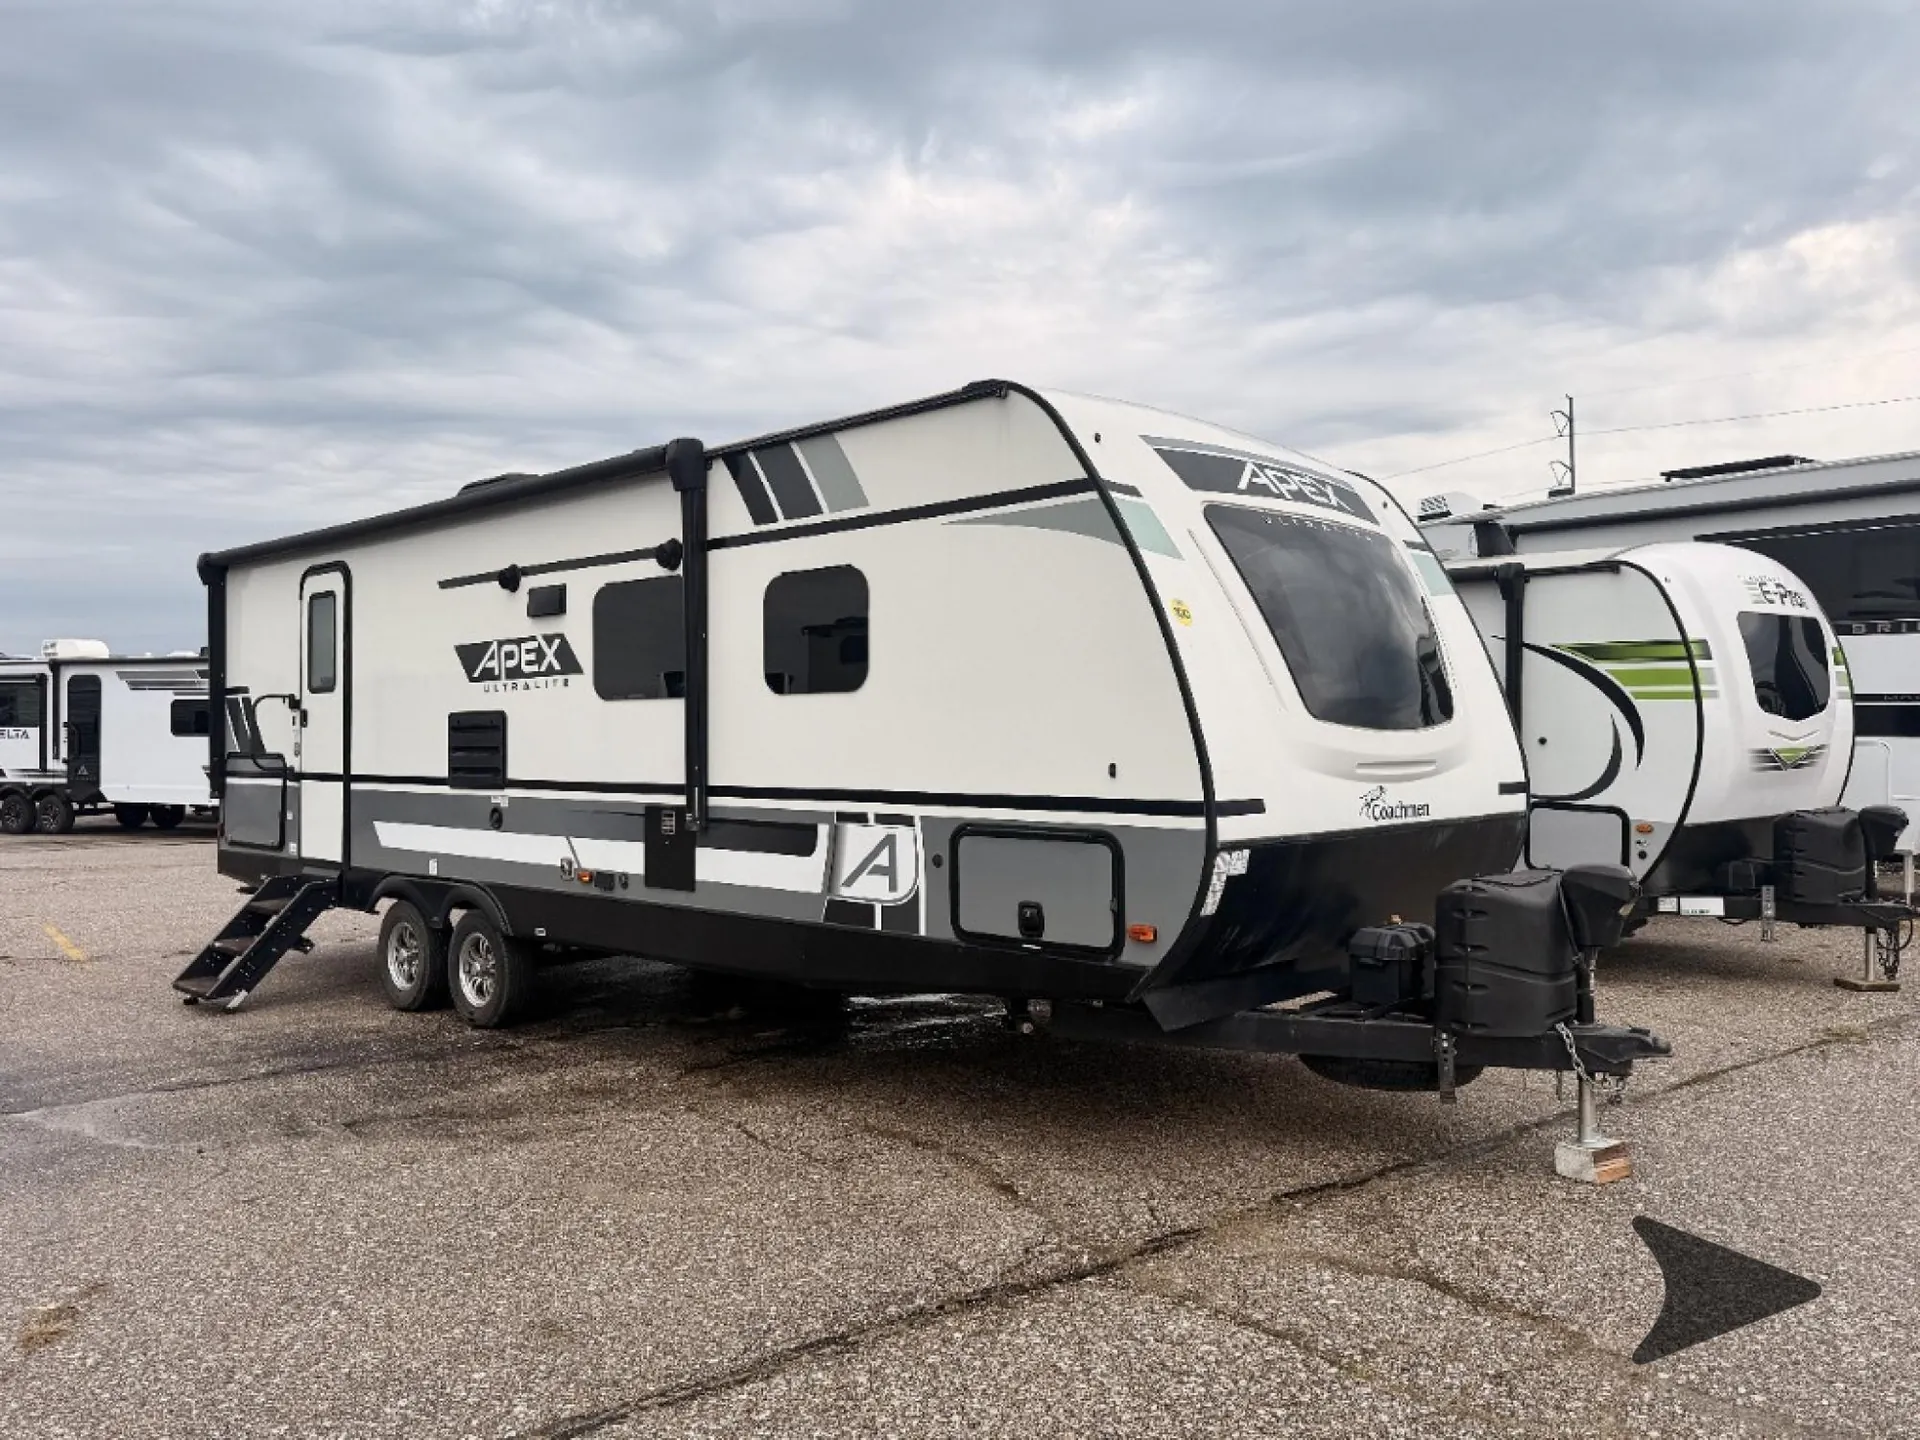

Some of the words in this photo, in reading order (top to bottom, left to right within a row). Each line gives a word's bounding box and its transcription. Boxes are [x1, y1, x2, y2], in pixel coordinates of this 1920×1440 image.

[1236, 461, 1355, 513] APEX
[472, 634, 562, 681] APEX
[483, 678, 570, 693] ULTRALITE
[1372, 800, 1431, 821] Coachmen
[841, 833, 897, 893] A
